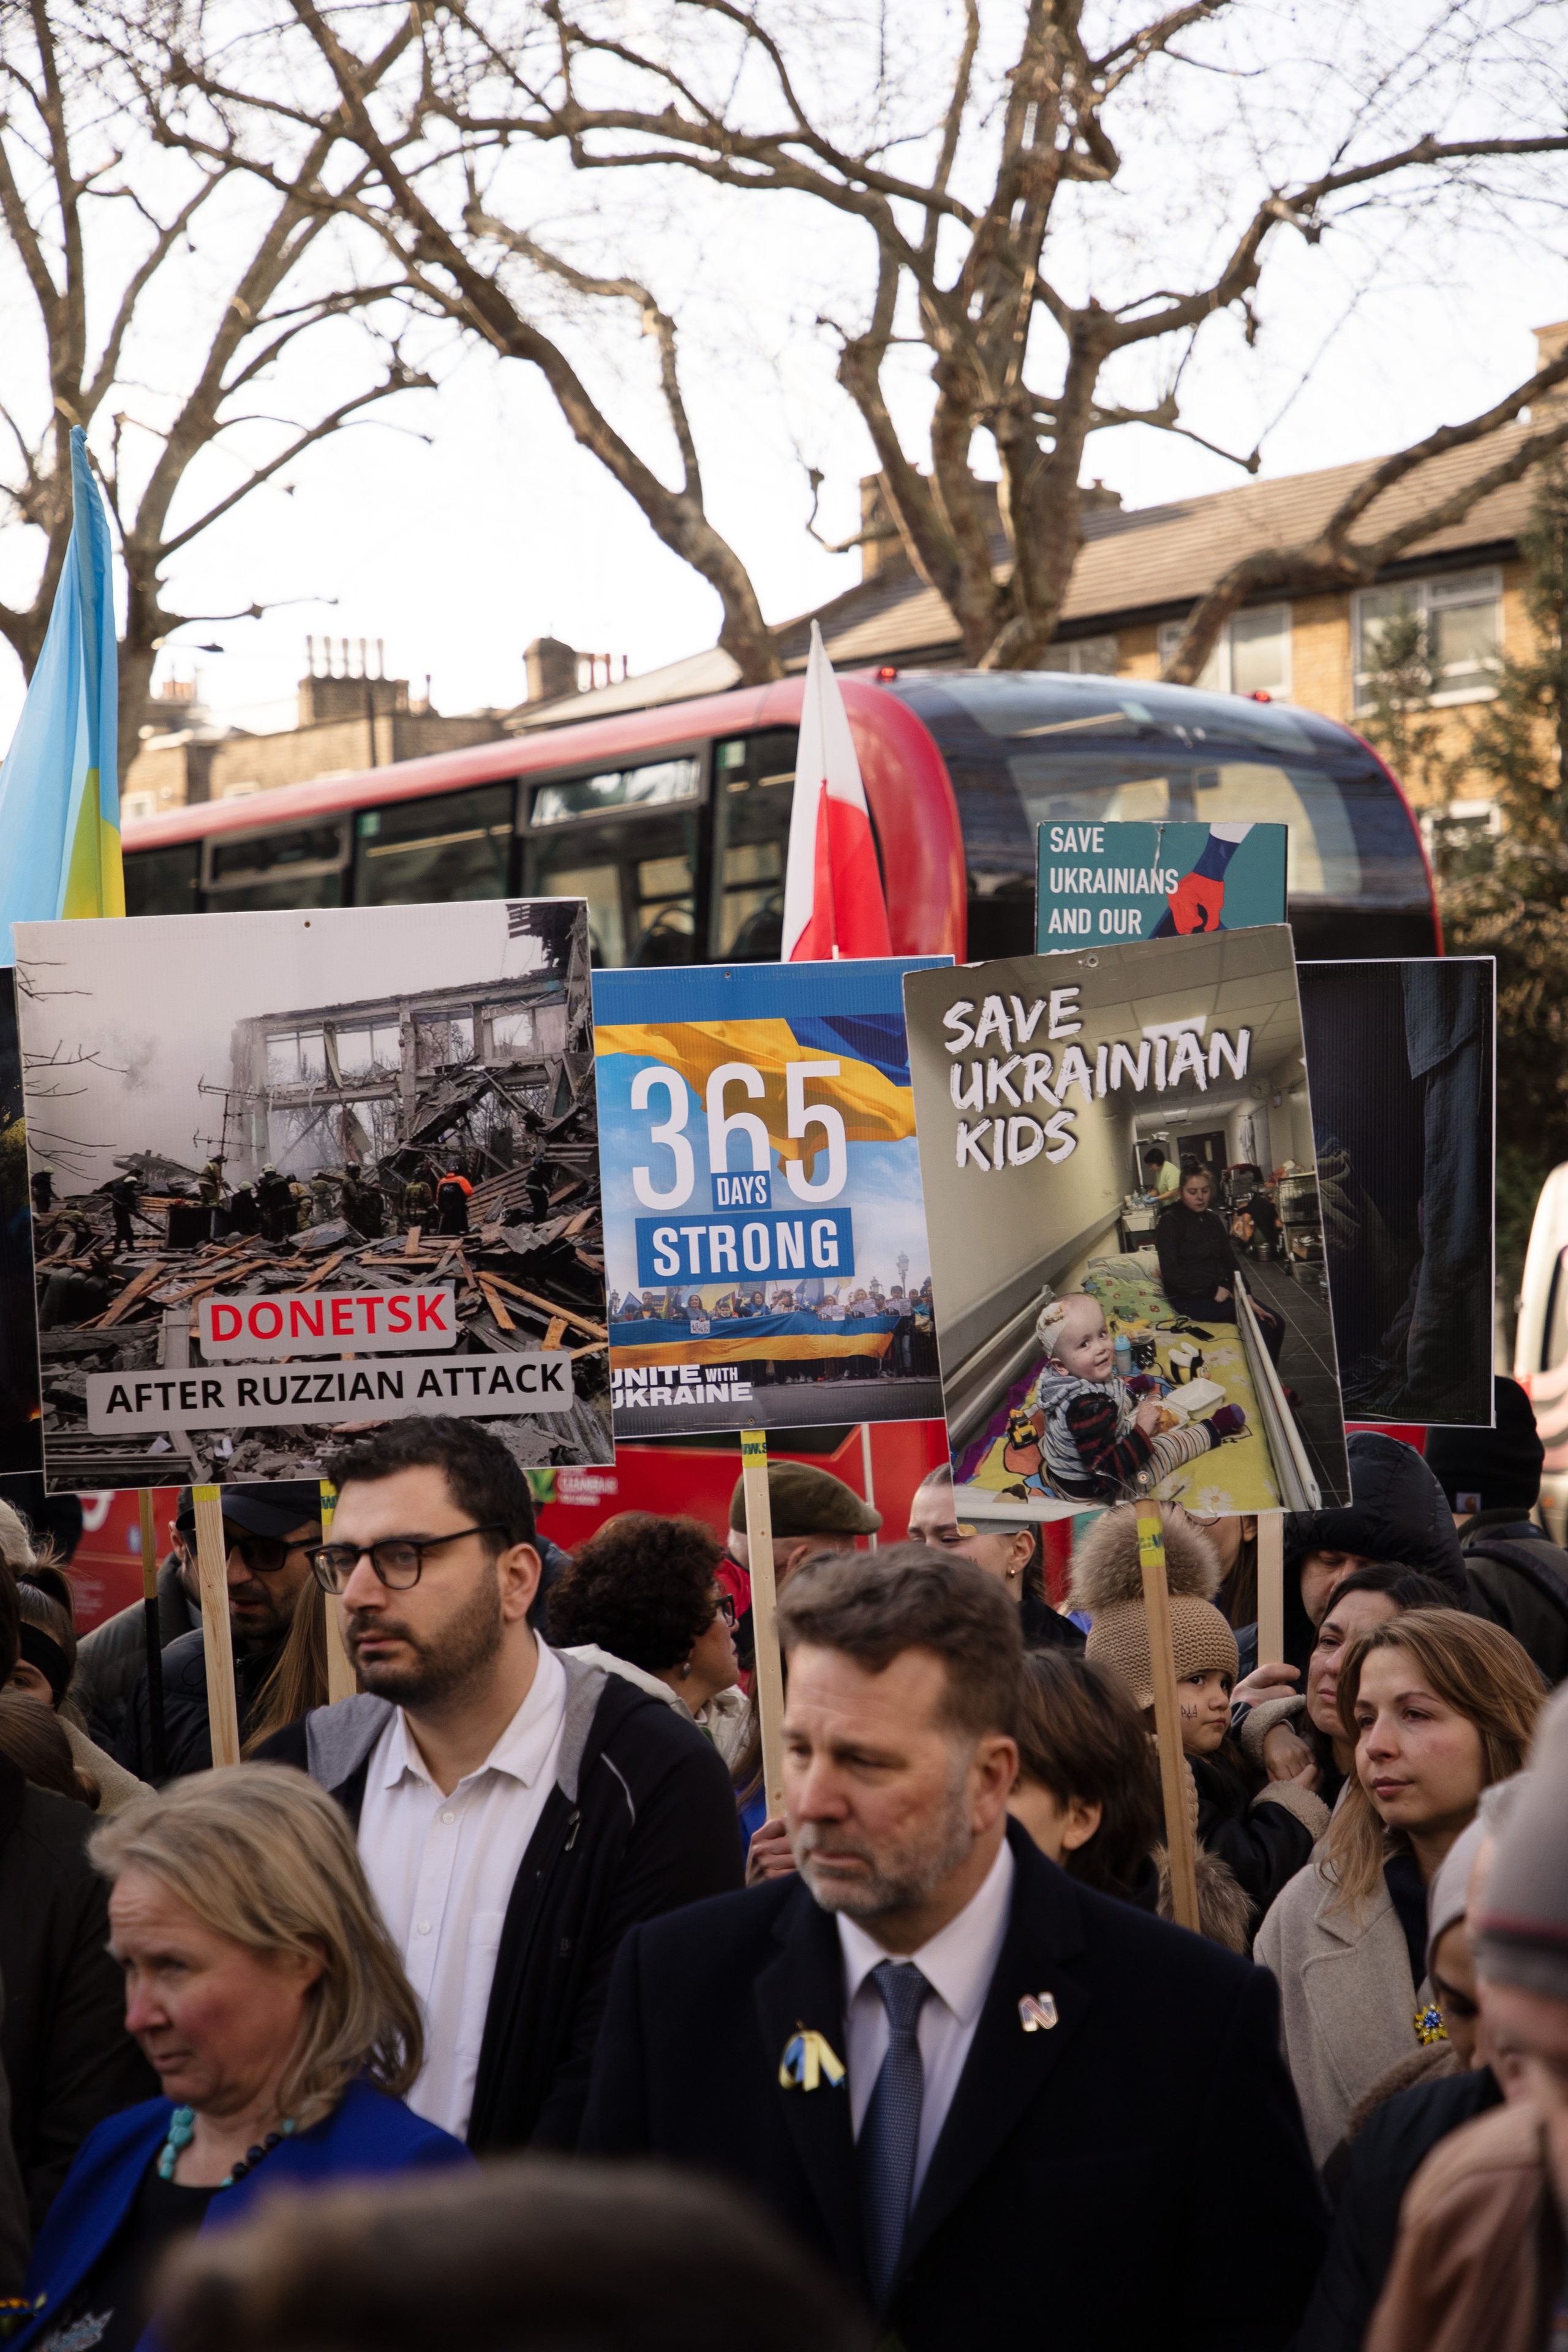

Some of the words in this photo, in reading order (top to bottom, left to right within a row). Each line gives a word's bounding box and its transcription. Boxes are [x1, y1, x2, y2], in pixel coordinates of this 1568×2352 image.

[1050, 826, 1105, 853] SAVE
[1050, 867, 1178, 894] UKRAINIANS
[1048, 908, 1091, 934] AND
[1098, 908, 1142, 935] OUR
[943, 987, 1082, 1054] SAVE
[950, 1028, 1250, 1113] UKRAINIAN
[630, 1060, 848, 1212] 365
[956, 1111, 1076, 1172] KIDS
[717, 1175, 767, 1205] DAYS
[653, 1219, 839, 1276] STRONG
[210, 1293, 448, 1342] DONETSK
[105, 1378, 225, 1414] AFTER
[237, 1371, 404, 1407] RUZZIAN
[417, 1363, 564, 1398] ATTACK
[704, 1366, 738, 1382] WITH
